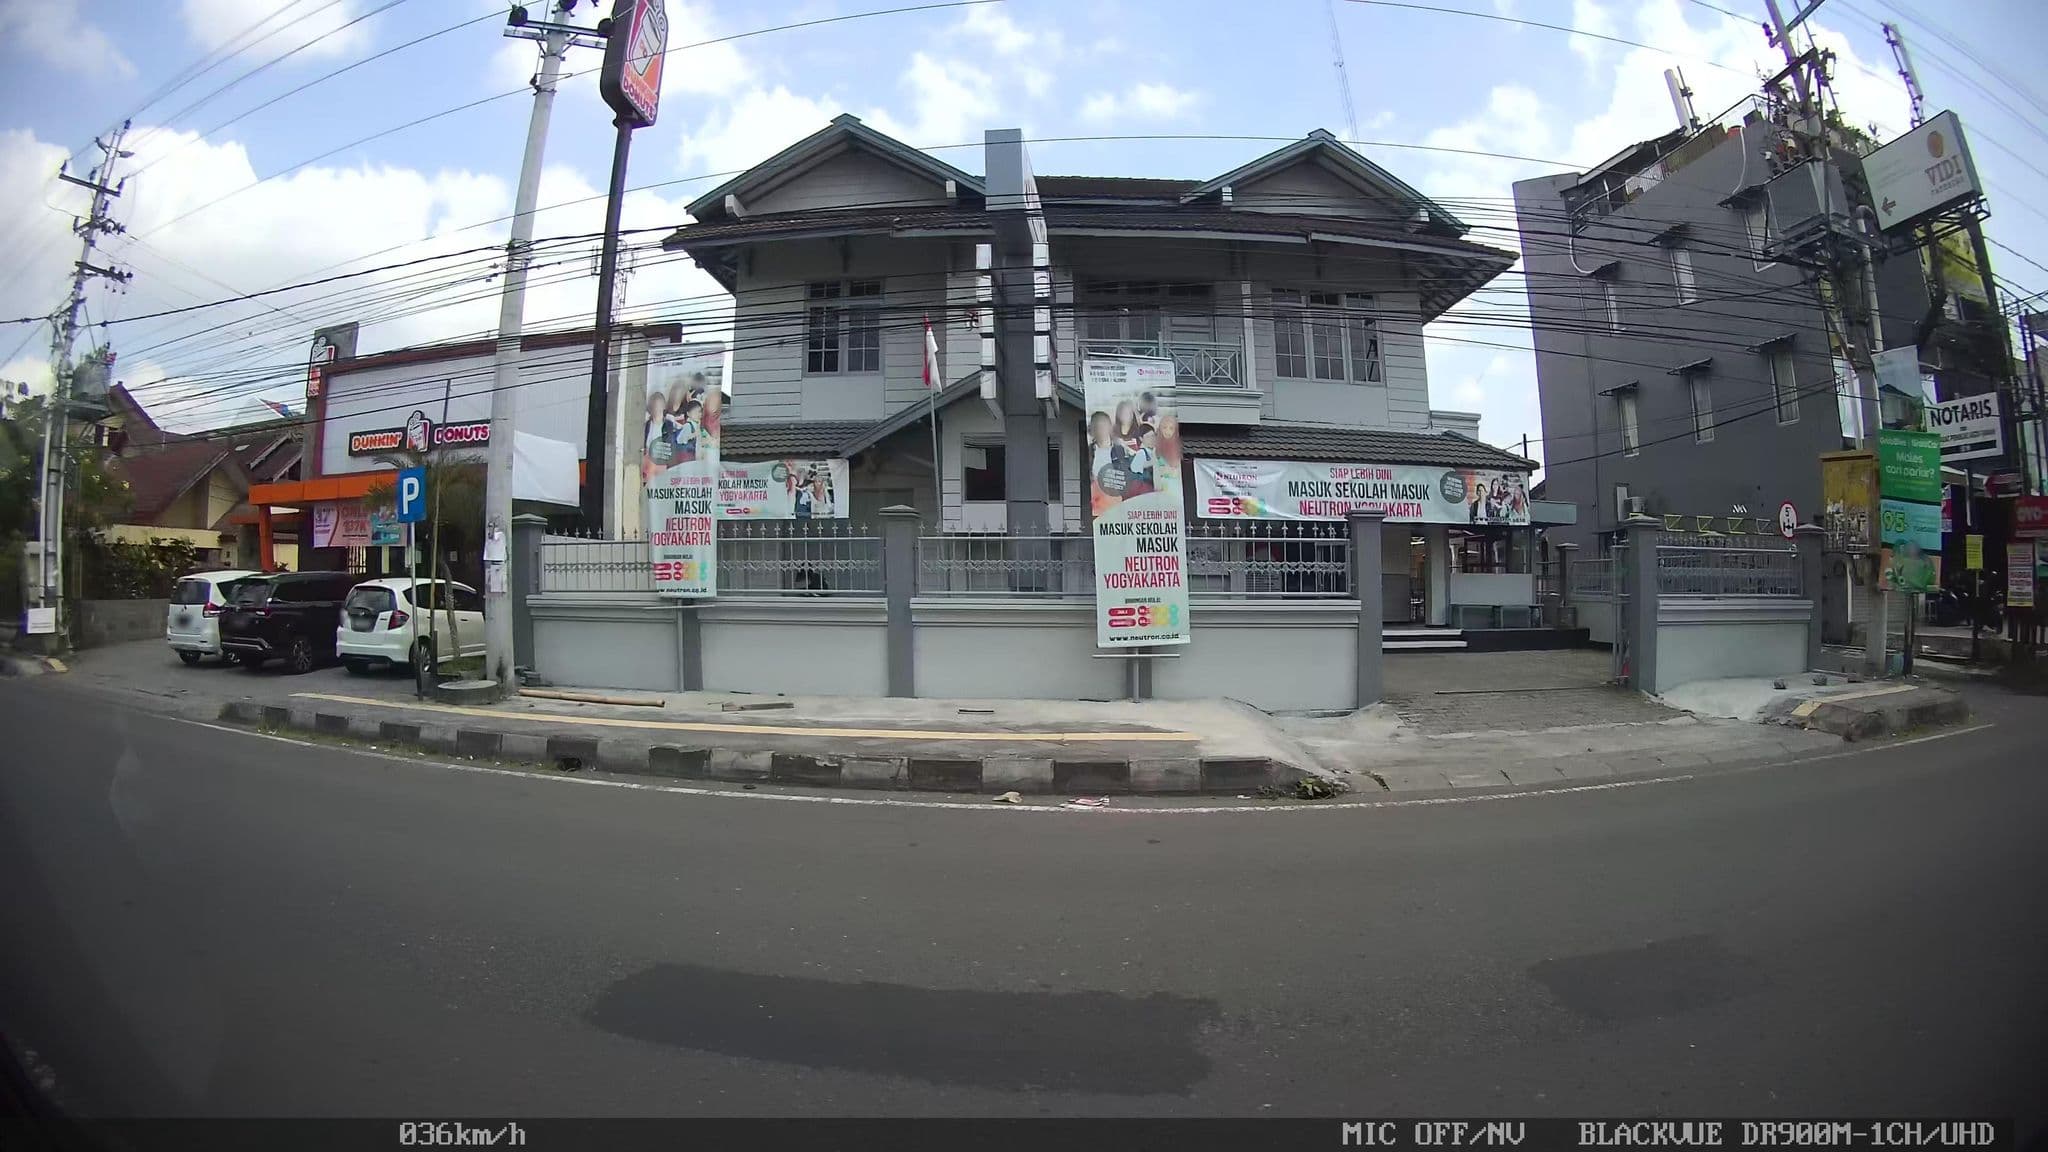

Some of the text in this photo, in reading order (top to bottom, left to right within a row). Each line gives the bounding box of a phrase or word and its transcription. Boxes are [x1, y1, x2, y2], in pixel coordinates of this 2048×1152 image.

[1924, 155, 1962, 186] VIDI
[1930, 399, 1992, 427] NOTARIS
[351, 423, 489, 452] DUNKIN' DONUTS
[1330, 467, 1392, 480] SIAP LEBIH DINI
[743, 479, 768, 489] MASUK
[1288, 481, 1332, 498] MASUK
[1335, 482, 1387, 500] SEKOLAH
[1391, 484, 1430, 501] MASUK
[402, 477, 420, 514] P
[675, 487, 712, 499] SEKOLAH
[675, 500, 712, 514] MASUK
[1127, 510, 1142, 520] SIAP
[1142, 510, 1162, 520] LEBIH
[1299, 500, 1352, 517] NEUTRON
[666, 517, 712, 532] NEUTRON
[1100, 522, 1178, 536] MASUK SEKOLAH
[1136, 537, 1179, 553] MASUK
[1125, 556, 1179, 572] NEUTRON
[1104, 572, 1180, 589] YOGYAKARTA
[1109, 633, 1180, 642] www.neutron.co.id
